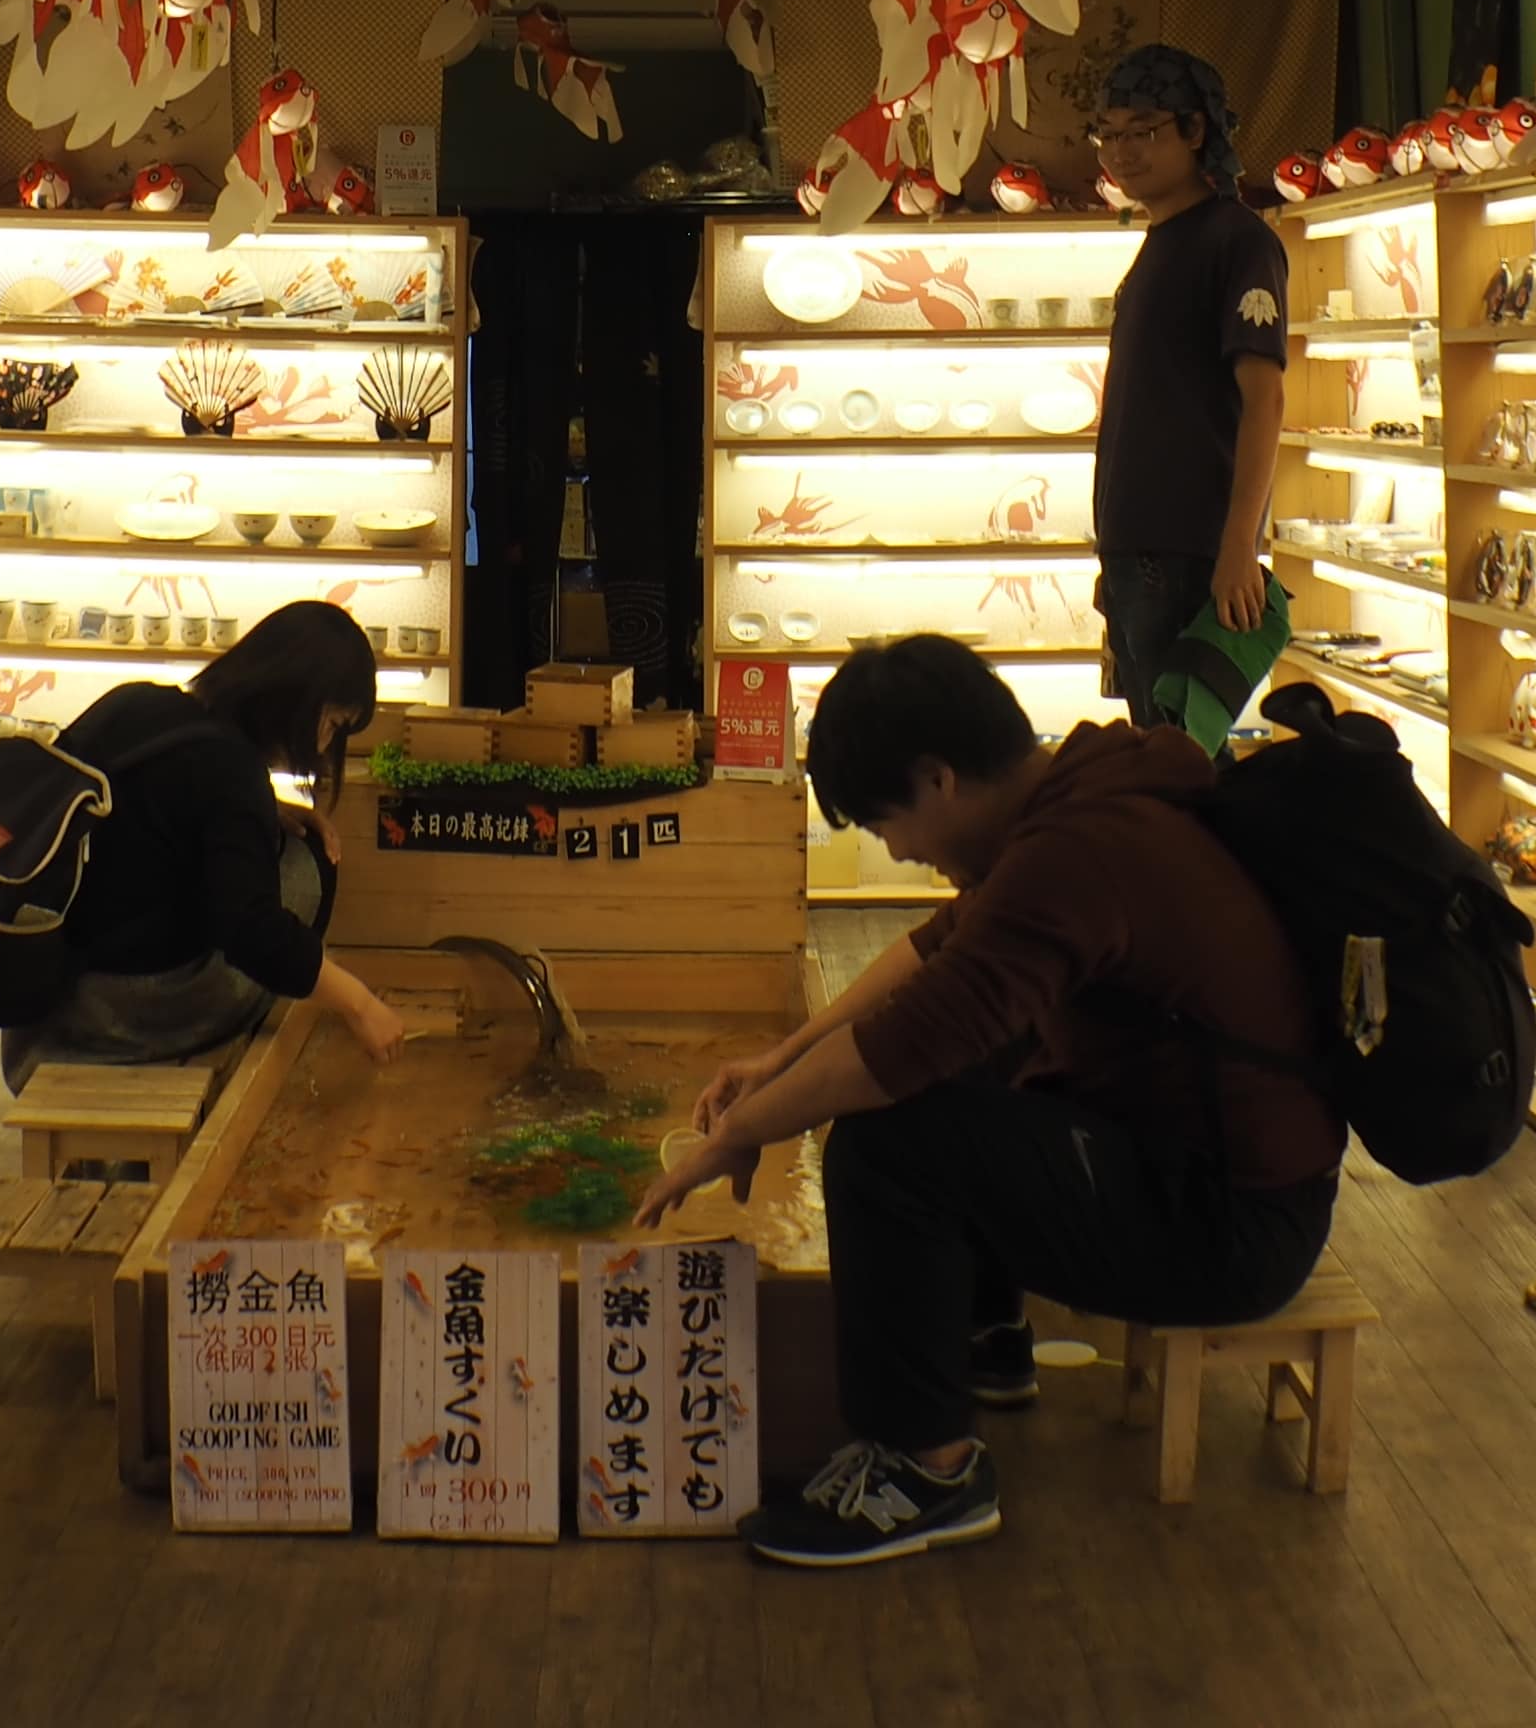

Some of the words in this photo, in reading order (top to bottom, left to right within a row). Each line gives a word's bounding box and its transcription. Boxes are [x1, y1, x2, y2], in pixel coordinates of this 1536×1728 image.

[720, 717, 780, 737] 5%還元
[409, 809, 529, 843] 本日の最高記録
[236, 1326, 278, 1348] 300
[444, 1263, 486, 1467] 金魚すくい
[678, 1250, 727, 1512] 遊びだけでも
[209, 1401, 308, 1423] GOLDFISH
[603, 1286, 651, 1522] 楽しめます
[179, 1428, 278, 1449] SCOOPING
[290, 1426, 341, 1449] GAME
